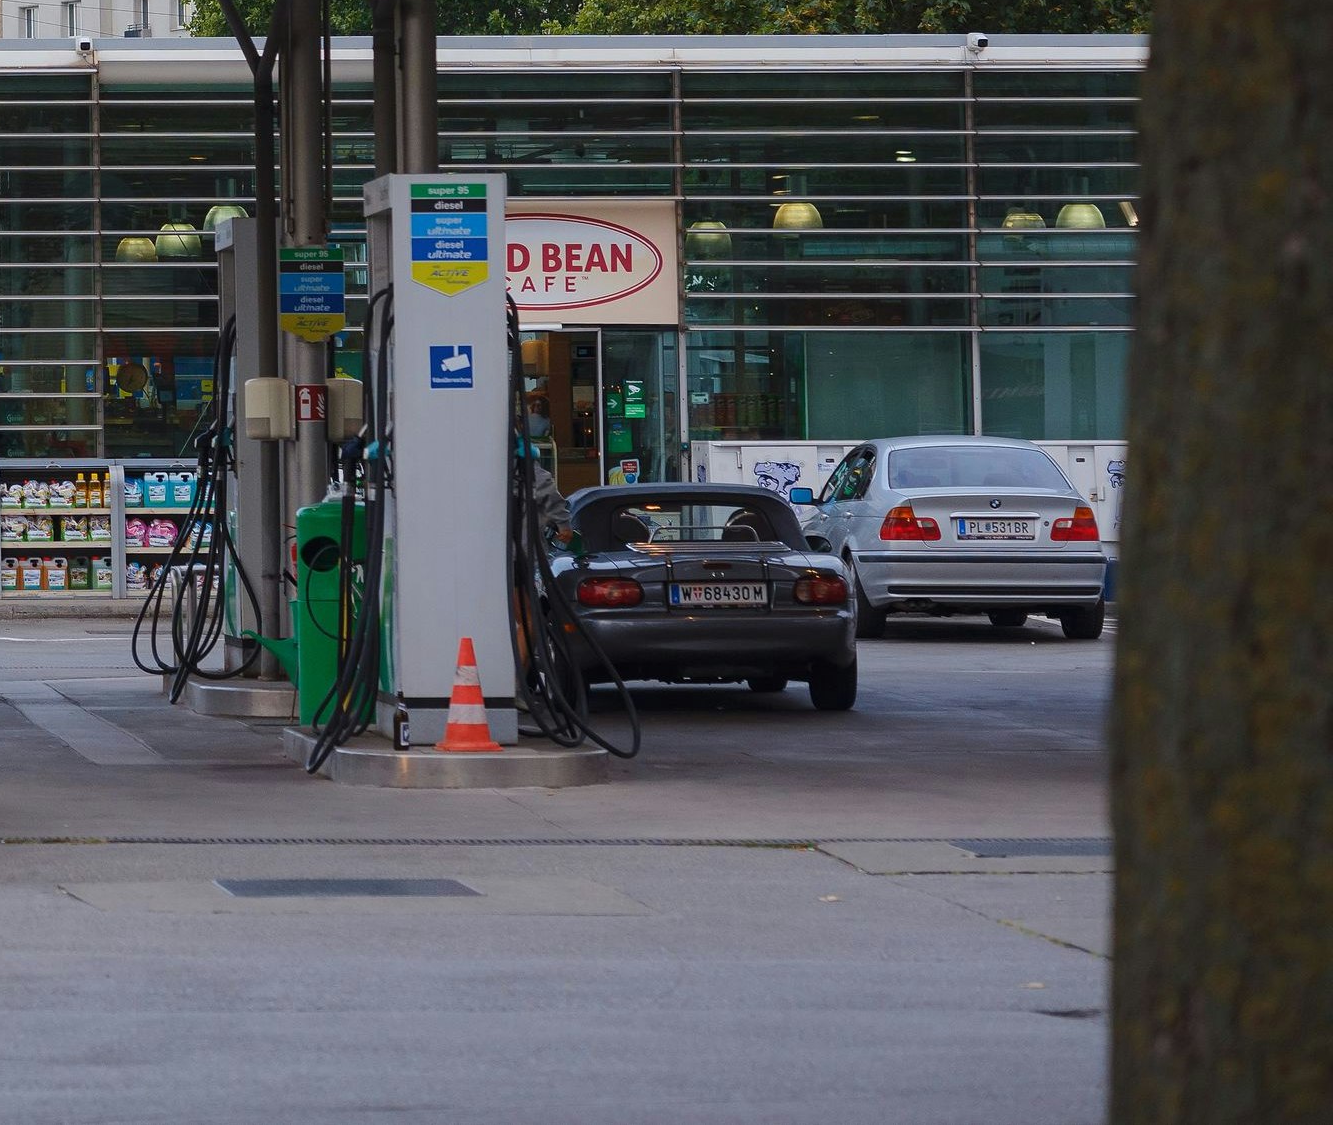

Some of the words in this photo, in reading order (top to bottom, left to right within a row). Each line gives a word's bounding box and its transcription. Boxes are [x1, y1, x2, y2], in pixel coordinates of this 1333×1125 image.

[428, 187, 454, 196] super
[457, 186, 469, 195] 95
[434, 201, 463, 210] diesel
[435, 240, 464, 249] diesel
[427, 250, 472, 259] ultimate
[542, 243, 633, 272] BEAN
[969, 522, 982, 533] PL
[681, 587, 692, 601] W
[703, 586, 750, 601] 68430
[753, 586, 763, 601] M
